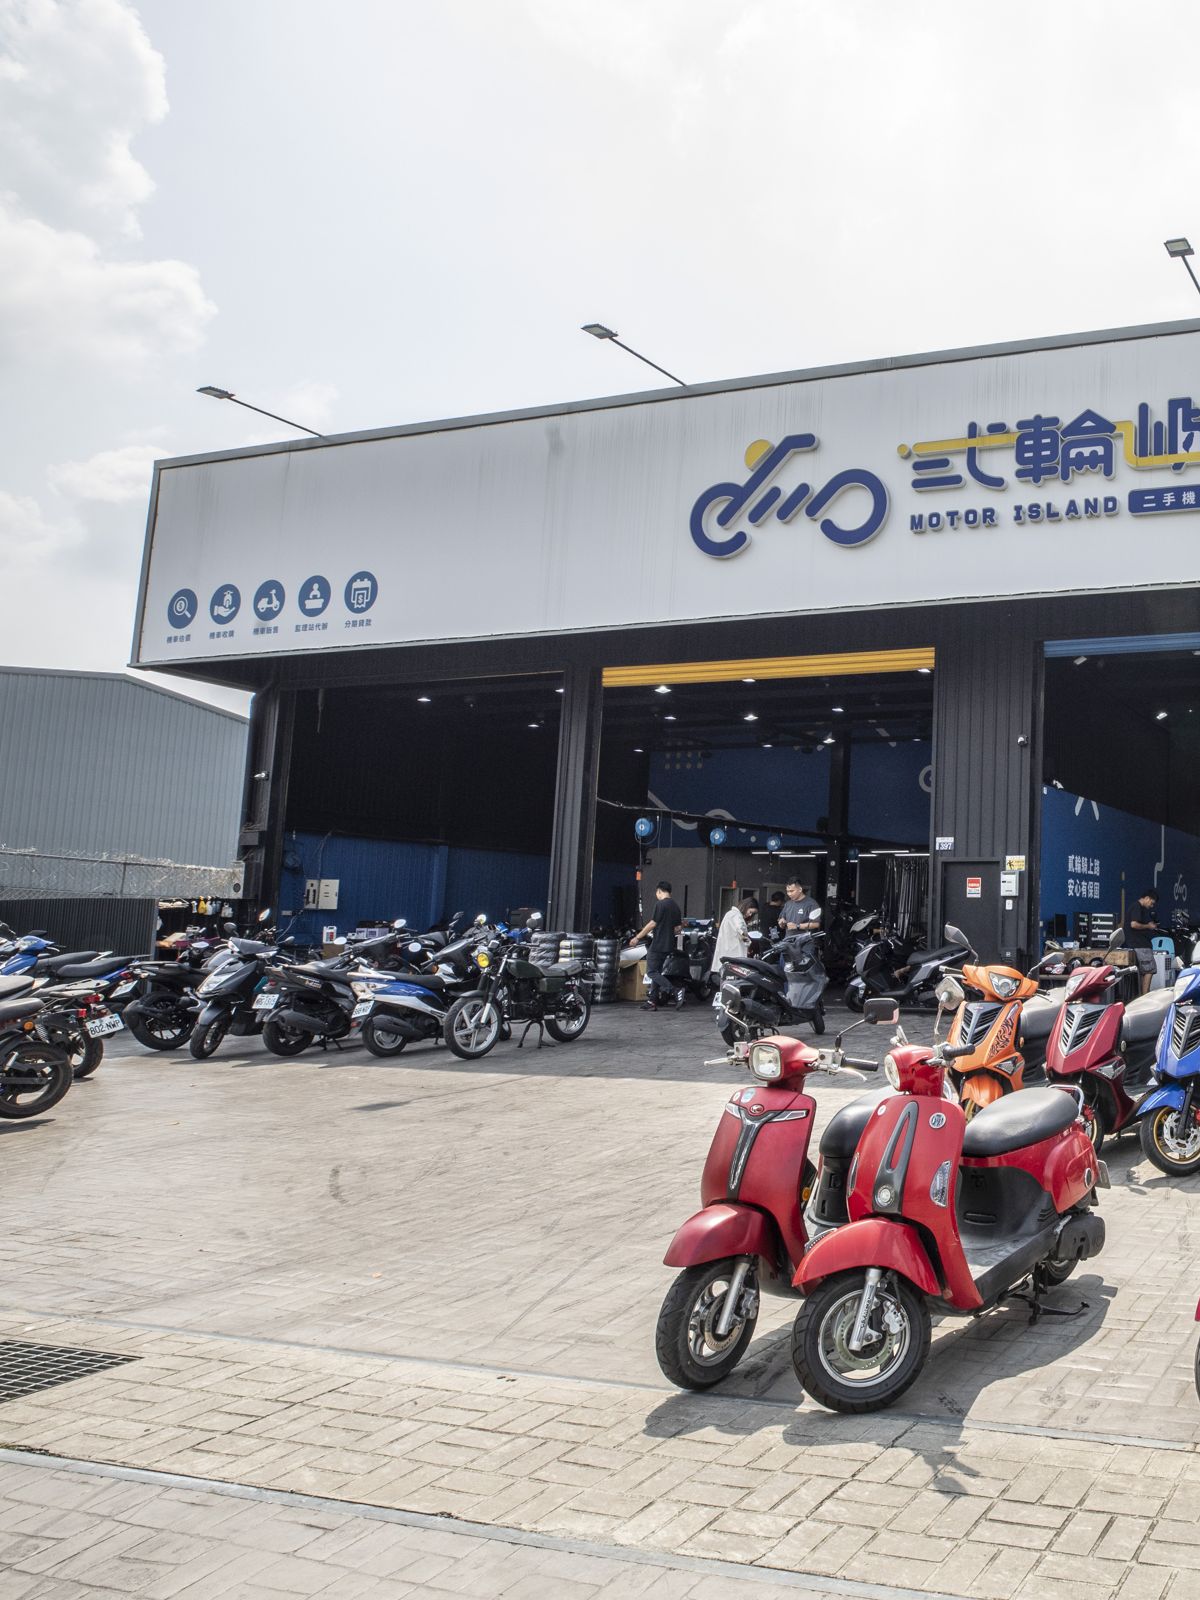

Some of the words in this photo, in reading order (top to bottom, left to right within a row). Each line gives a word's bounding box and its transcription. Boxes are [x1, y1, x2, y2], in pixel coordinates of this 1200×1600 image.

[910, 507, 997, 531] MOTOR
[1013, 496, 1118, 521] ISLAND
[940, 842, 952, 850] 397
[1067, 878, 1100, 899] 安心有保固
